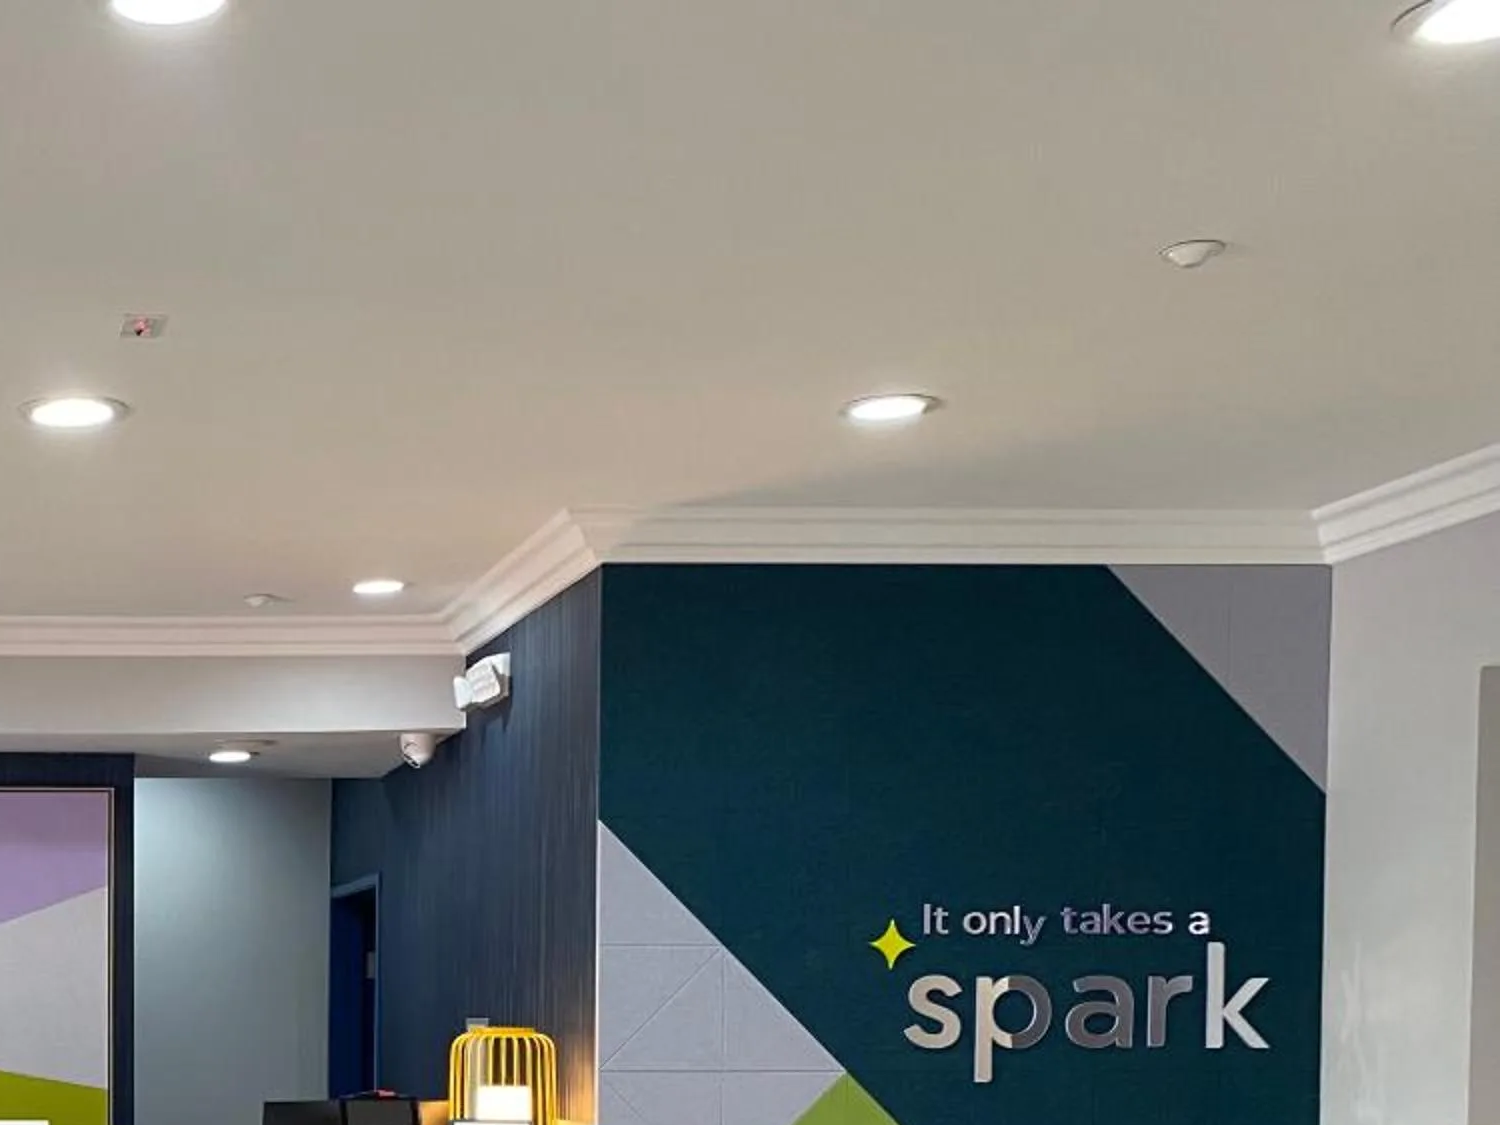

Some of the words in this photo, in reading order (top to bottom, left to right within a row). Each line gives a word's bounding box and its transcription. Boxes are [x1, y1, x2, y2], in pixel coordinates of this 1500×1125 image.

[922, 904, 949, 935] It
[962, 904, 1046, 945] only
[1060, 903, 1173, 935] takes
[1187, 911, 1211, 935] a
[903, 941, 1271, 1083] spark
